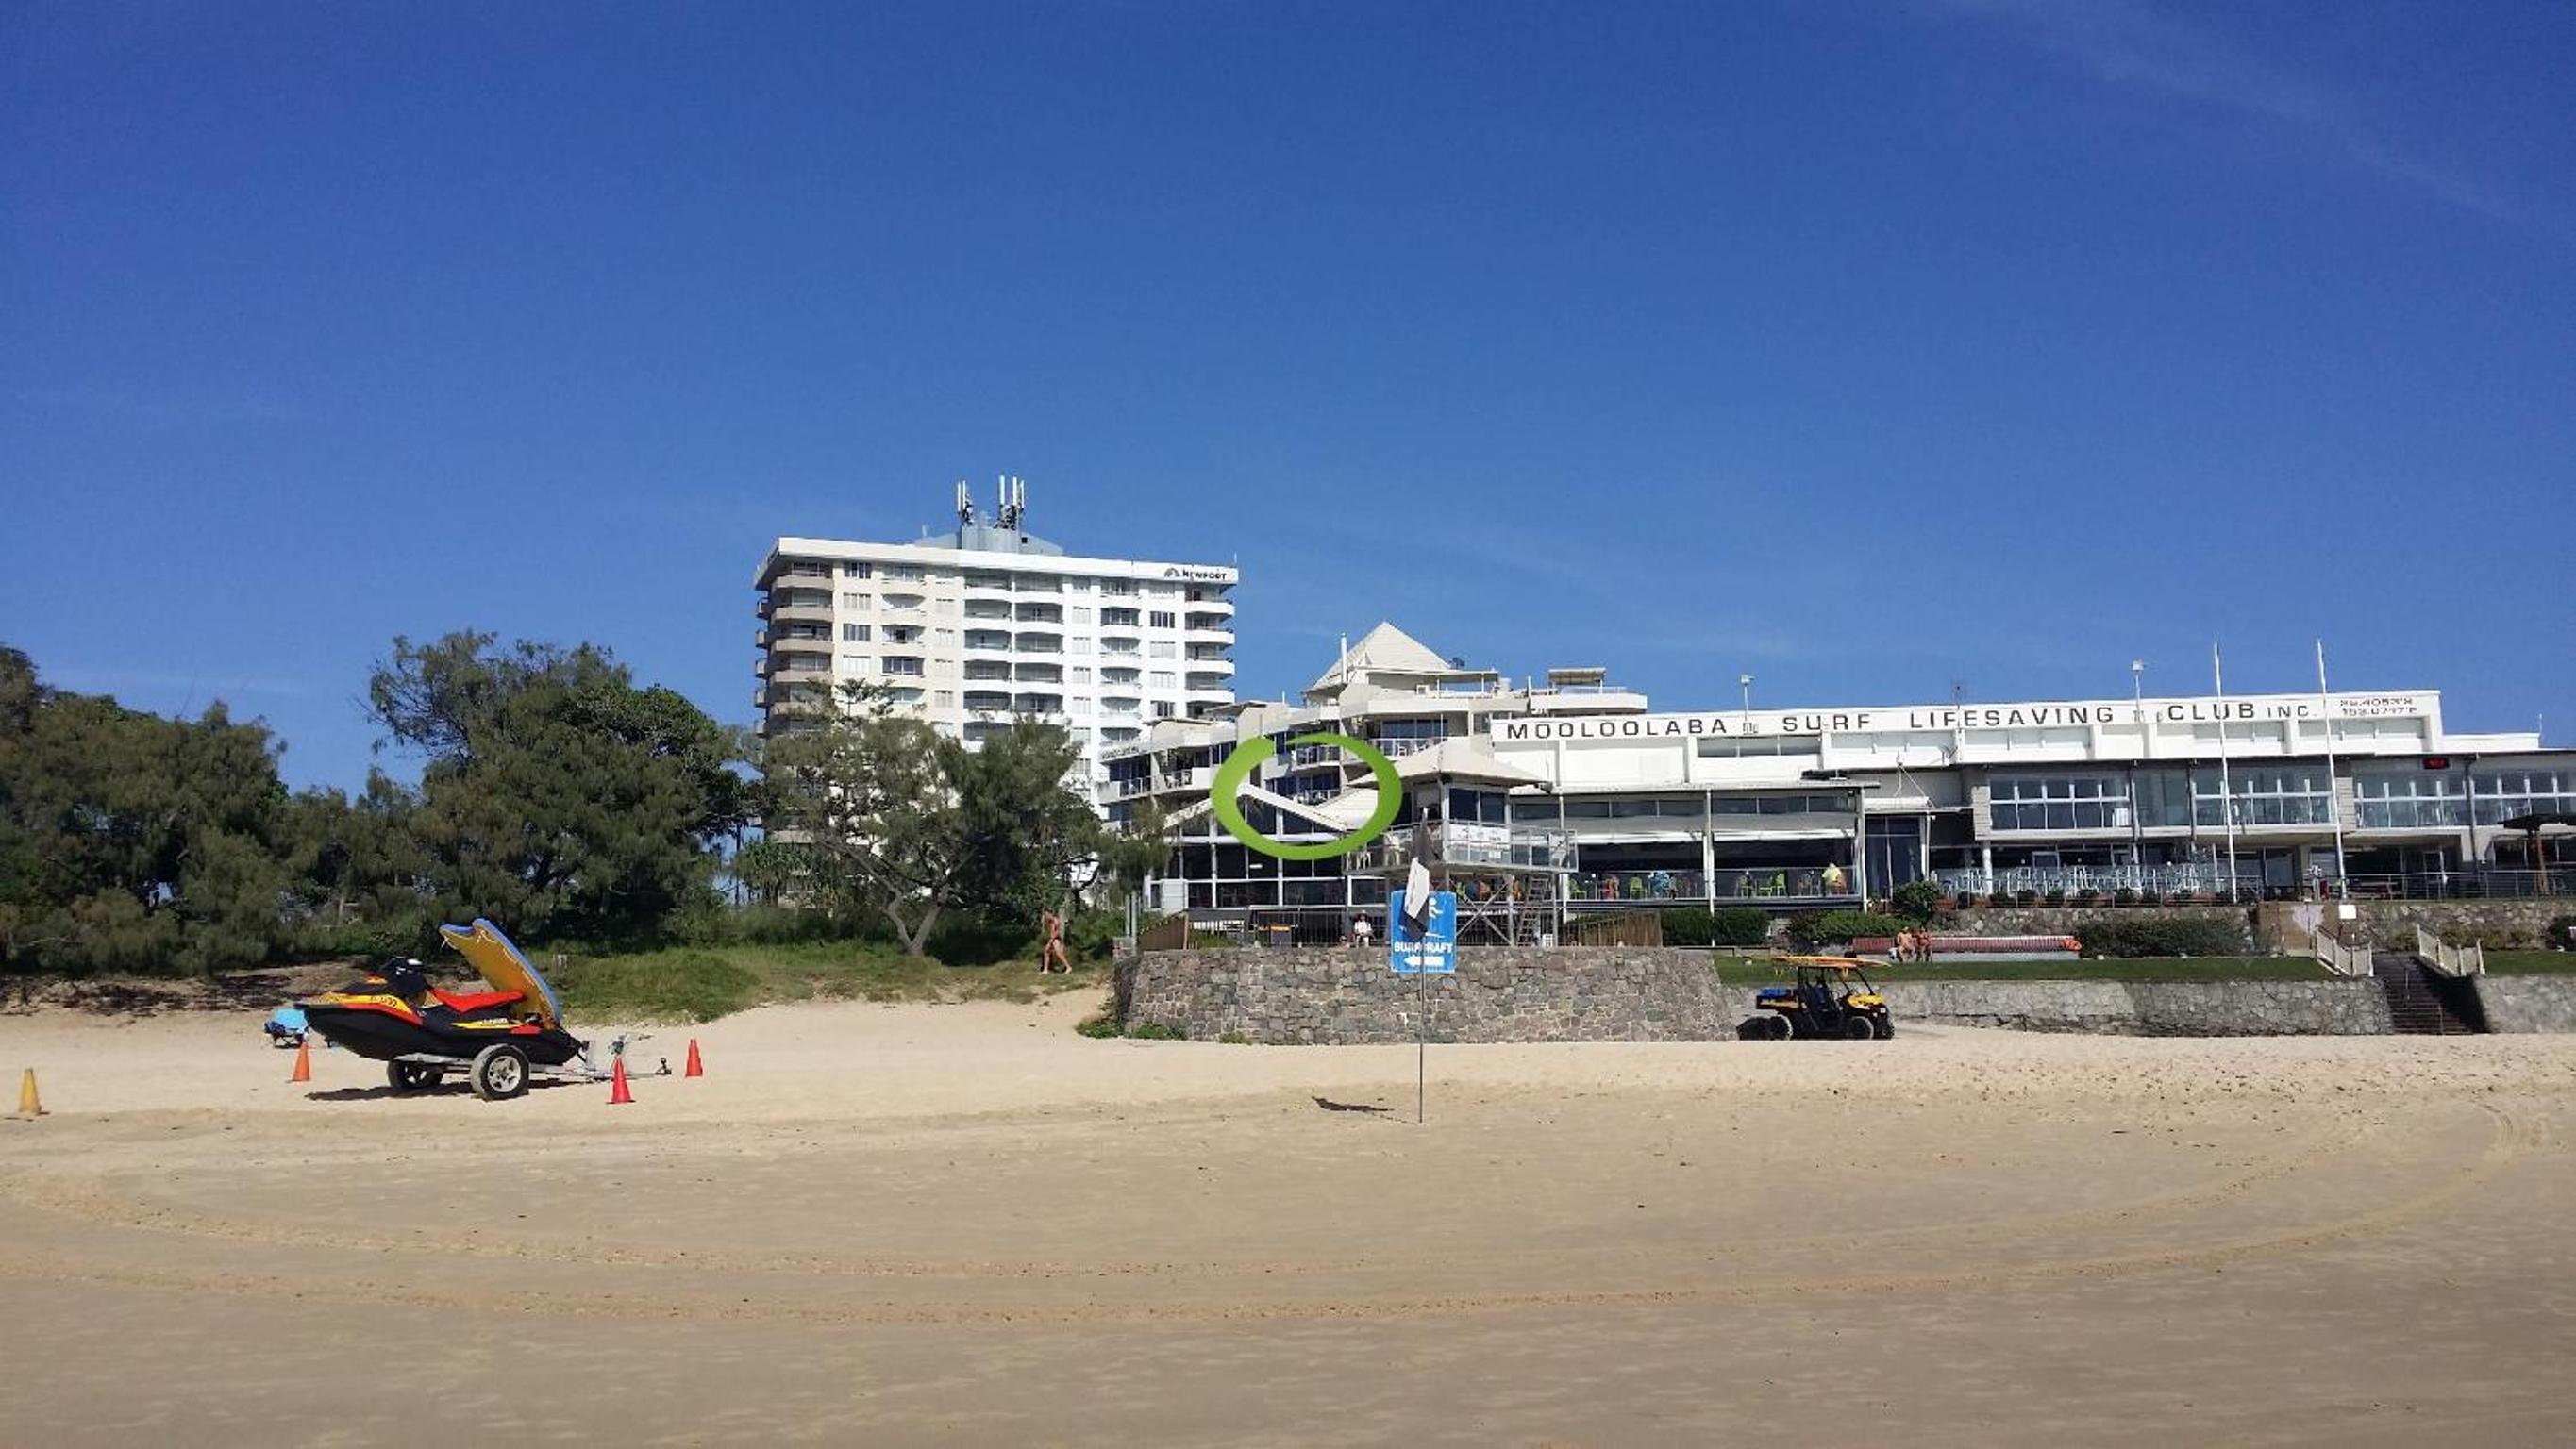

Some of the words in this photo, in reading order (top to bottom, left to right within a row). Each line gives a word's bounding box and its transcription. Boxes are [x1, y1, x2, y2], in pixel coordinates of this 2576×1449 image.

[1507, 718, 1727, 739] MOOLOOLABA
[1782, 714, 1870, 732] SURF
[1910, 706, 2114, 728] LIFESAVING
[2168, 703, 2254, 720] CLUB
[1394, 941, 1453, 953] SURFRAFT
